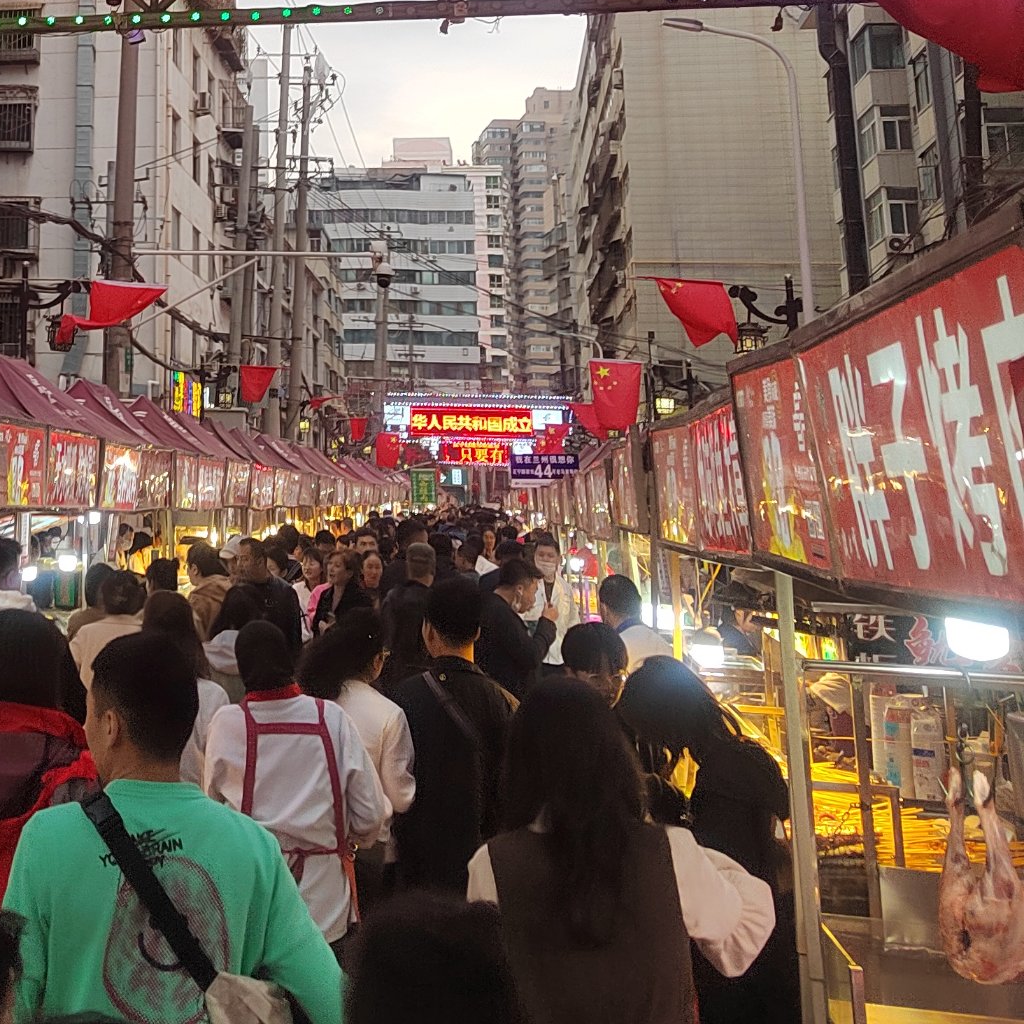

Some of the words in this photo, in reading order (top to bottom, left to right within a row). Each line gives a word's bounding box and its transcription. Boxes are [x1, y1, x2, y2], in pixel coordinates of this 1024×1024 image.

[411, 413, 532, 433] 华人民共和国成立
